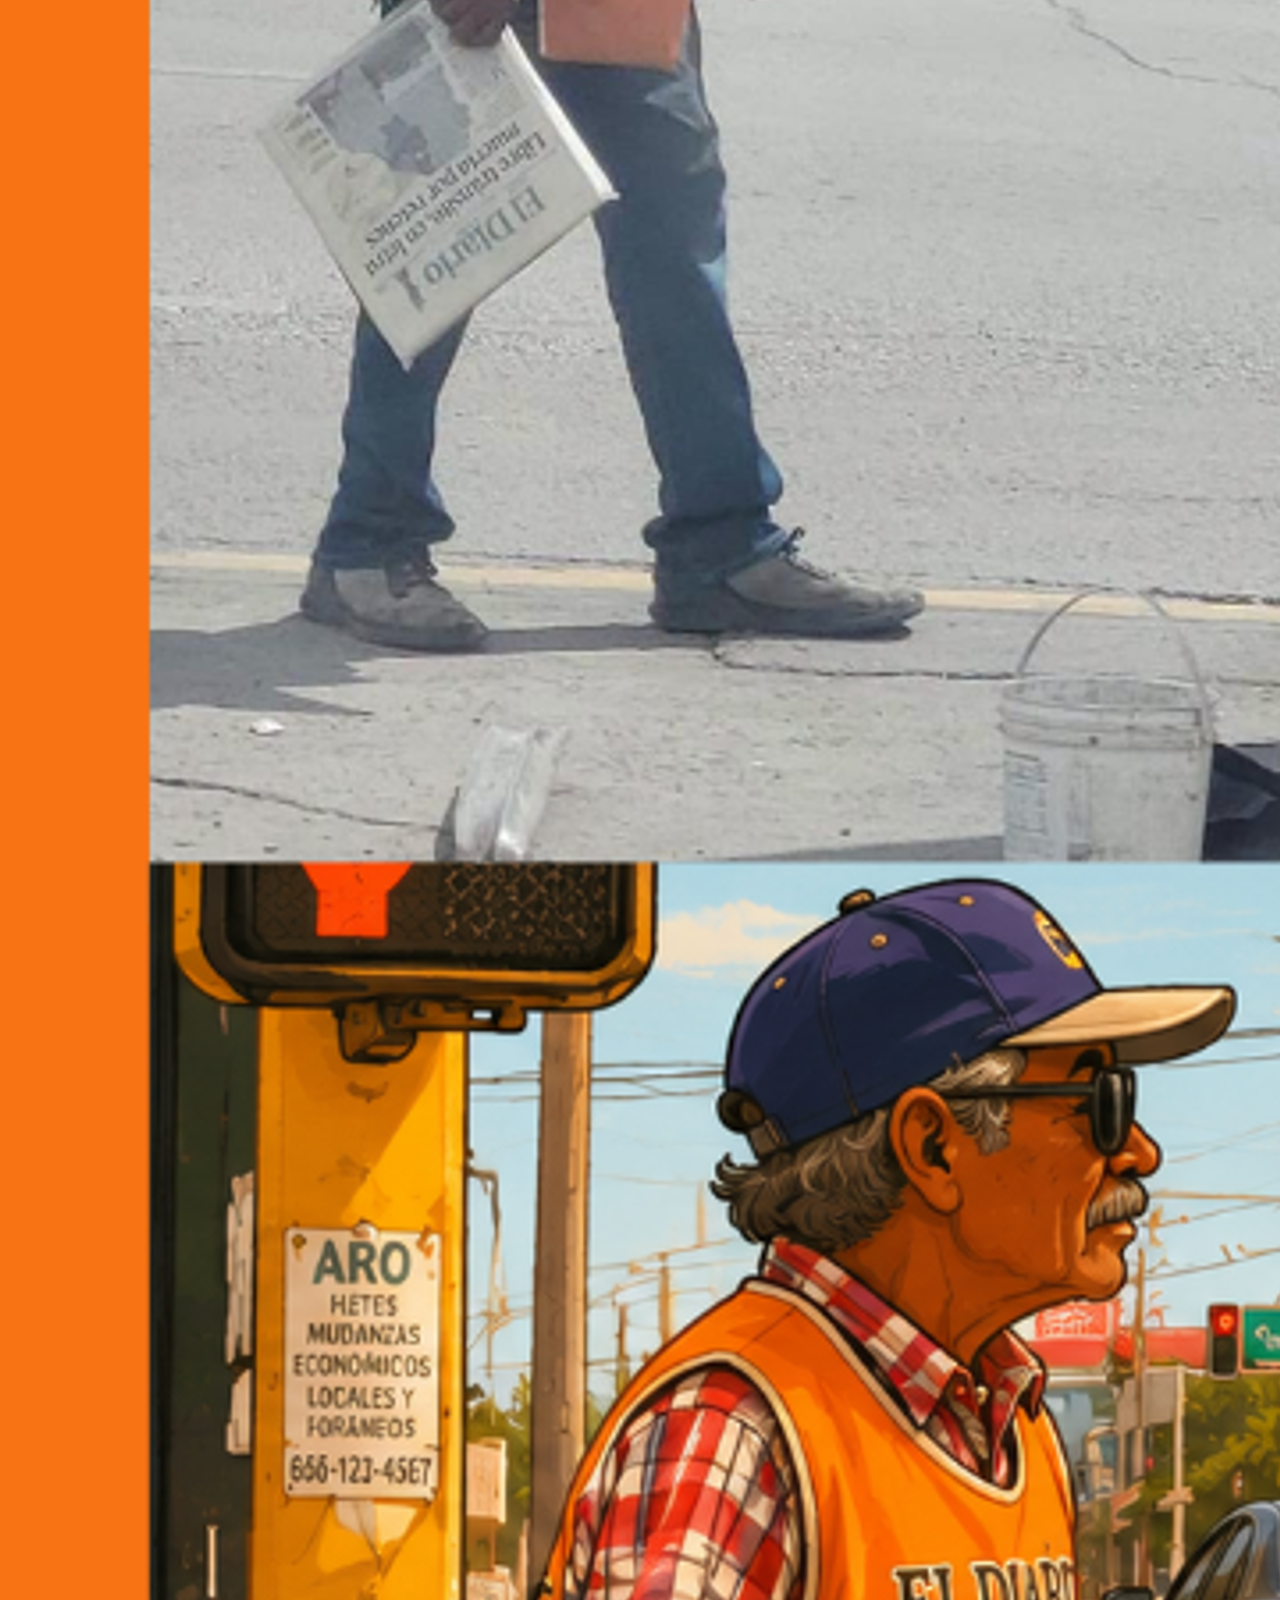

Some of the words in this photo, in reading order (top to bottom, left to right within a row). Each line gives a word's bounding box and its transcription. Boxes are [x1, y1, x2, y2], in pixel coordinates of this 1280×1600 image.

[510, 185, 546, 223] El
[312, 1238, 412, 1286] ARO
[305, 1322, 421, 1345] MUDANZAS
[306, 1386, 396, 1409] LOCALES
[401, 1387, 415, 1409] Y
